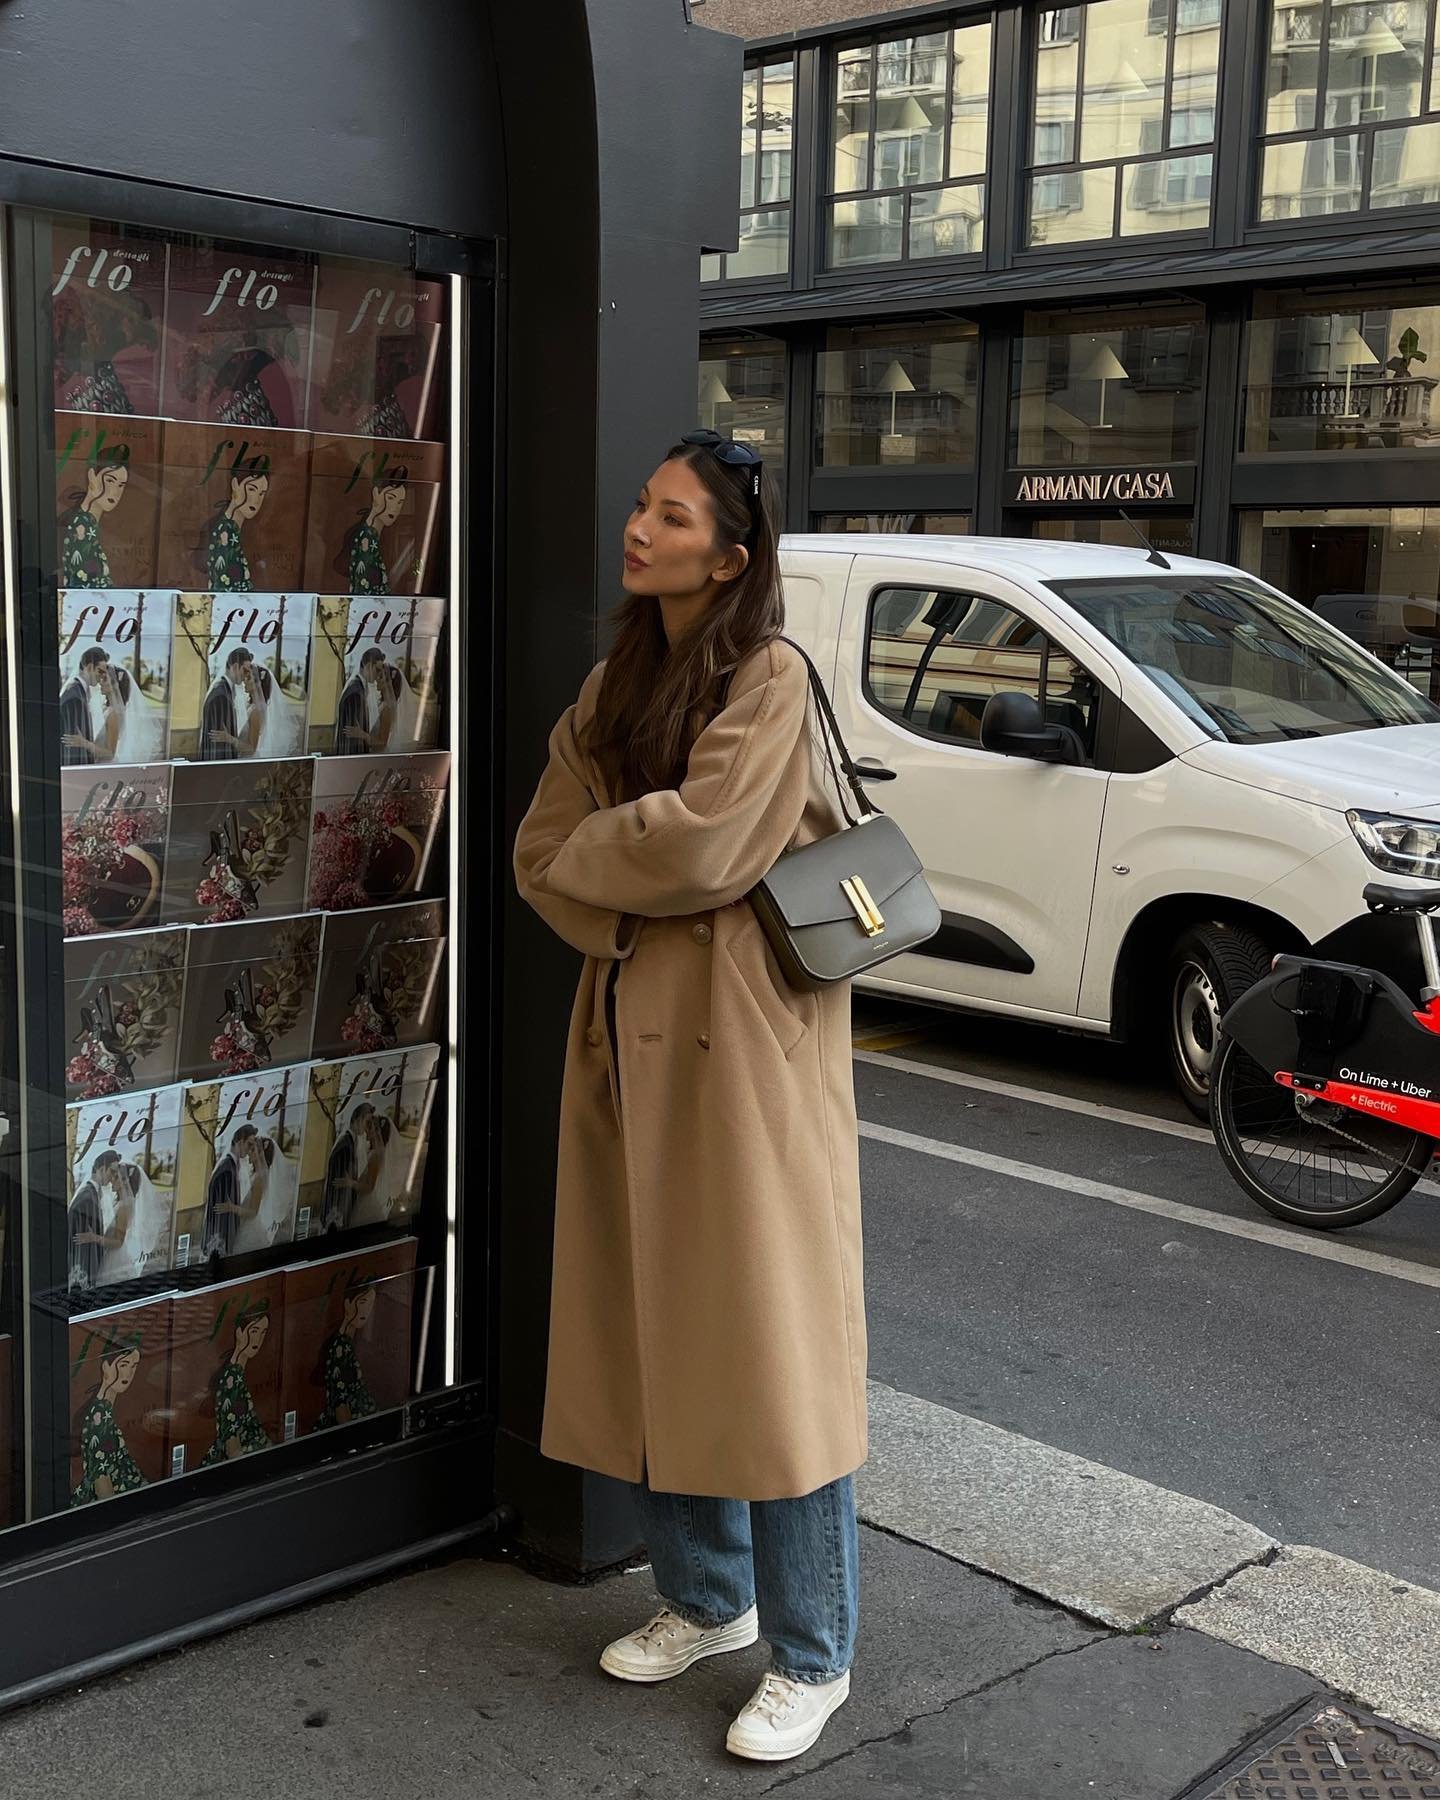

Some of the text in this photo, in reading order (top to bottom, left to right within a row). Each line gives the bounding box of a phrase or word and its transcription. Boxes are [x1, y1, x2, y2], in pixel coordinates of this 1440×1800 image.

[53, 246, 132, 296] flo
[201, 267, 278, 316] flo
[345, 288, 415, 334] flo
[199, 440, 271, 485] flo
[1016, 472, 1175, 500] ARMANI/CASA
[60, 605, 138, 655] flo
[210, 608, 279, 655] flo
[345, 610, 410, 655] flo
[336, 1067, 401, 1114] flo
[1340, 1068, 1357, 1081] On
[1360, 1072, 1388, 1088] Lime
[1401, 1081, 1432, 1098] Uber
[1358, 1095, 1397, 1114] Electric
[216, 1087, 284, 1137] flo
[74, 1111, 150, 1164] flo
